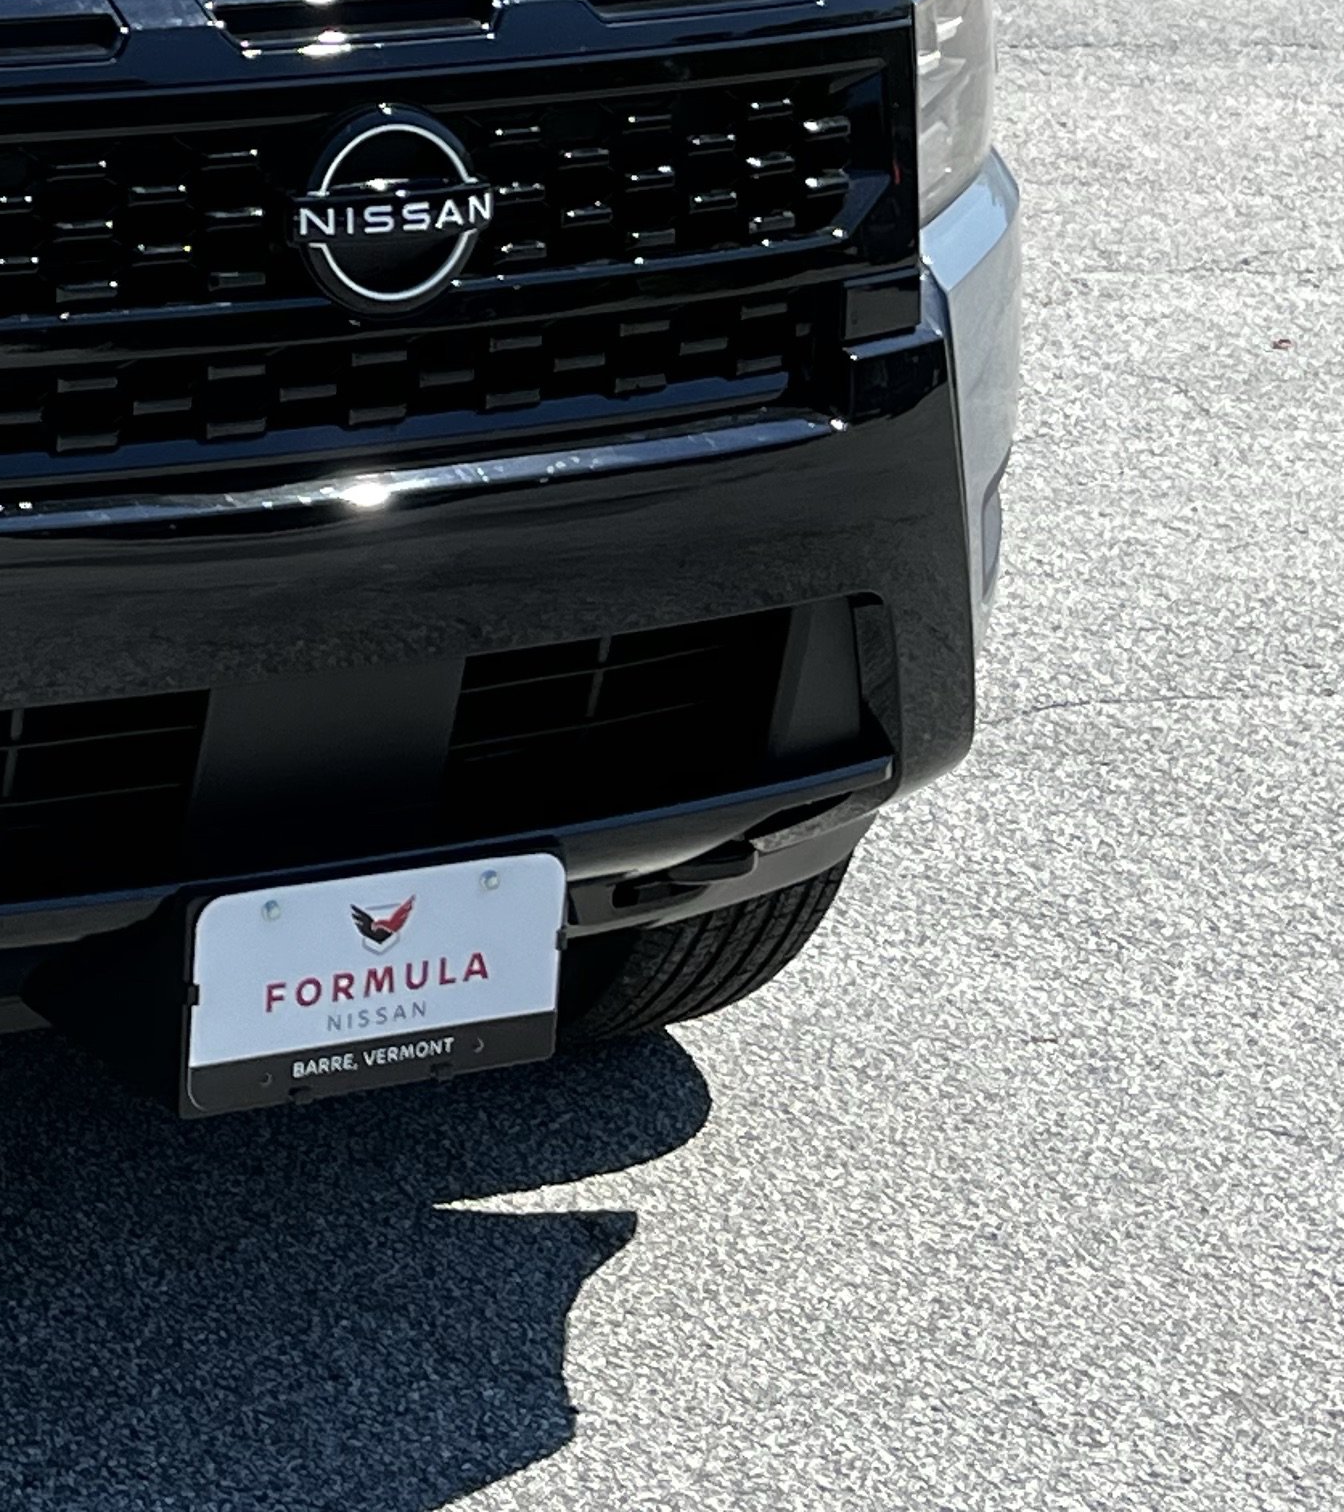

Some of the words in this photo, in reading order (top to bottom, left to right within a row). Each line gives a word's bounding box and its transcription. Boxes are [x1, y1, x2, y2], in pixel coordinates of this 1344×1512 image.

[298, 192, 493, 237] NISSAN
[265, 951, 490, 1013] FORMULA
[326, 1000, 429, 1032] NISSAN
[291, 1055, 359, 1079] BARRE,
[363, 1037, 456, 1068] VERMONT
